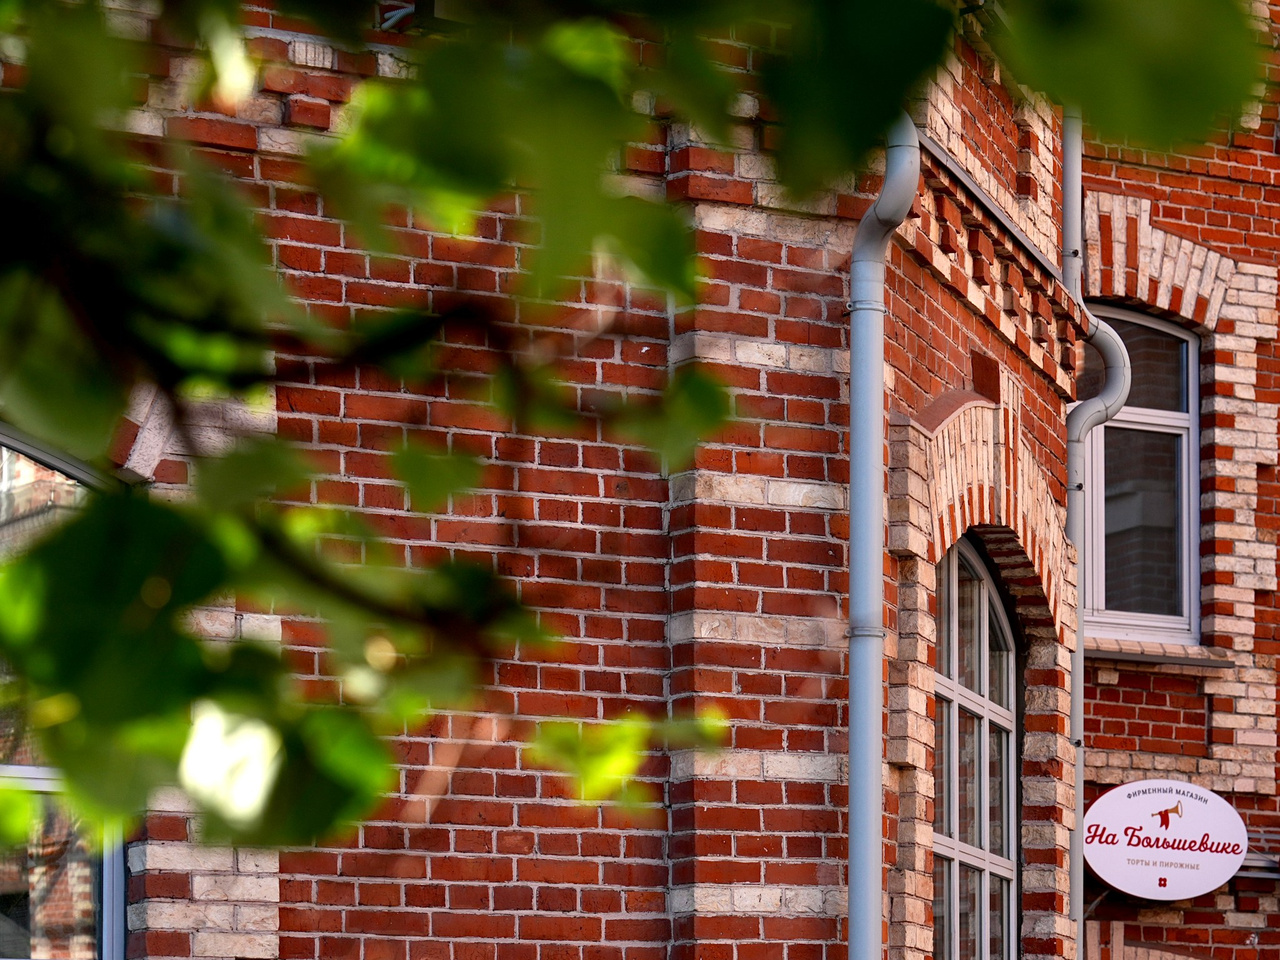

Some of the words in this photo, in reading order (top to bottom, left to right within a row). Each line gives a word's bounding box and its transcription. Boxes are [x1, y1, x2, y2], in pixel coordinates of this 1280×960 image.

[1126, 786, 1174, 799] ФИРМЕННЫЙ
[1175, 788, 1209, 805] МАГАЗИН
[1085, 823, 1119, 845] На
[1123, 825, 1244, 856] Большевике
[1126, 858, 1150, 867] ТОРТЫ
[1159, 861, 1200, 870] ПИРОЖНЫЕ
